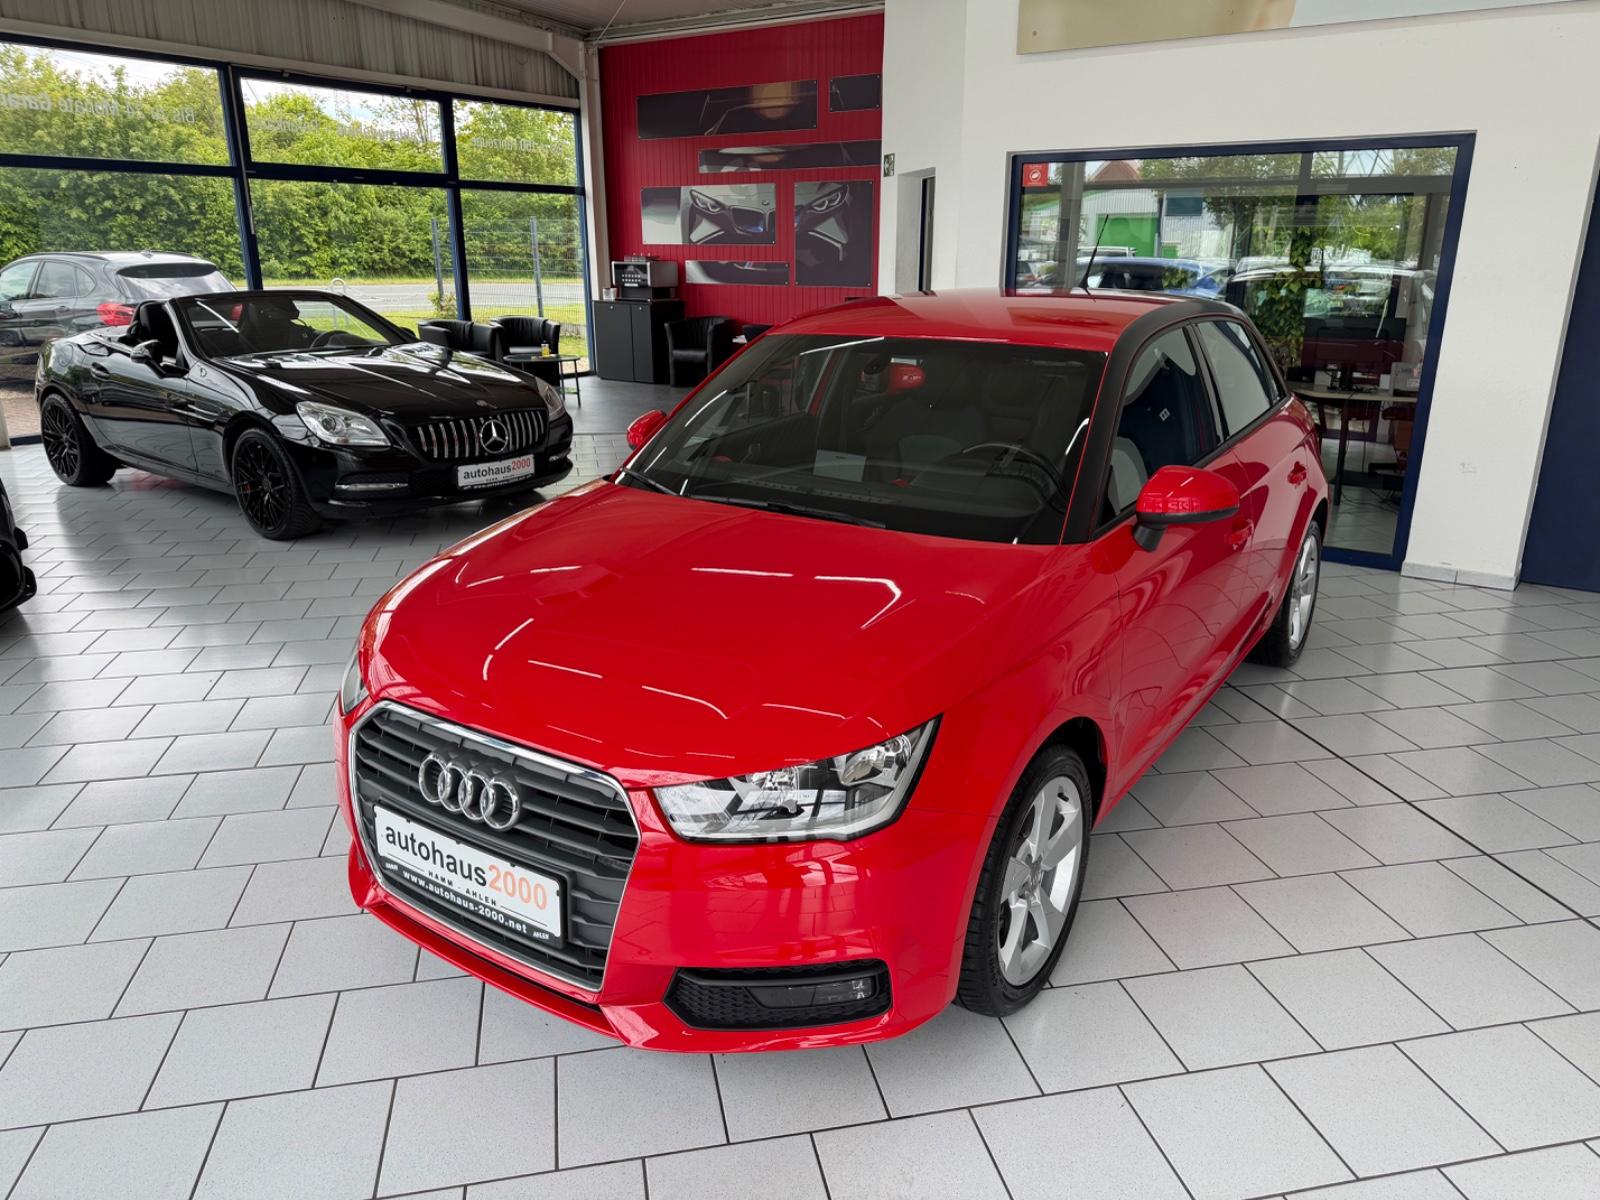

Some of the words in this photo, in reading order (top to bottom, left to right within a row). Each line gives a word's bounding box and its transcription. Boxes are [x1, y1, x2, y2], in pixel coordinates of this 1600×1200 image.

[463, 458, 531, 480] autohaus2000
[385, 826, 549, 911] autohaus2000
[402, 870, 528, 934] www.autohaus-2000.net
[465, 887, 498, 907] AHLEN
